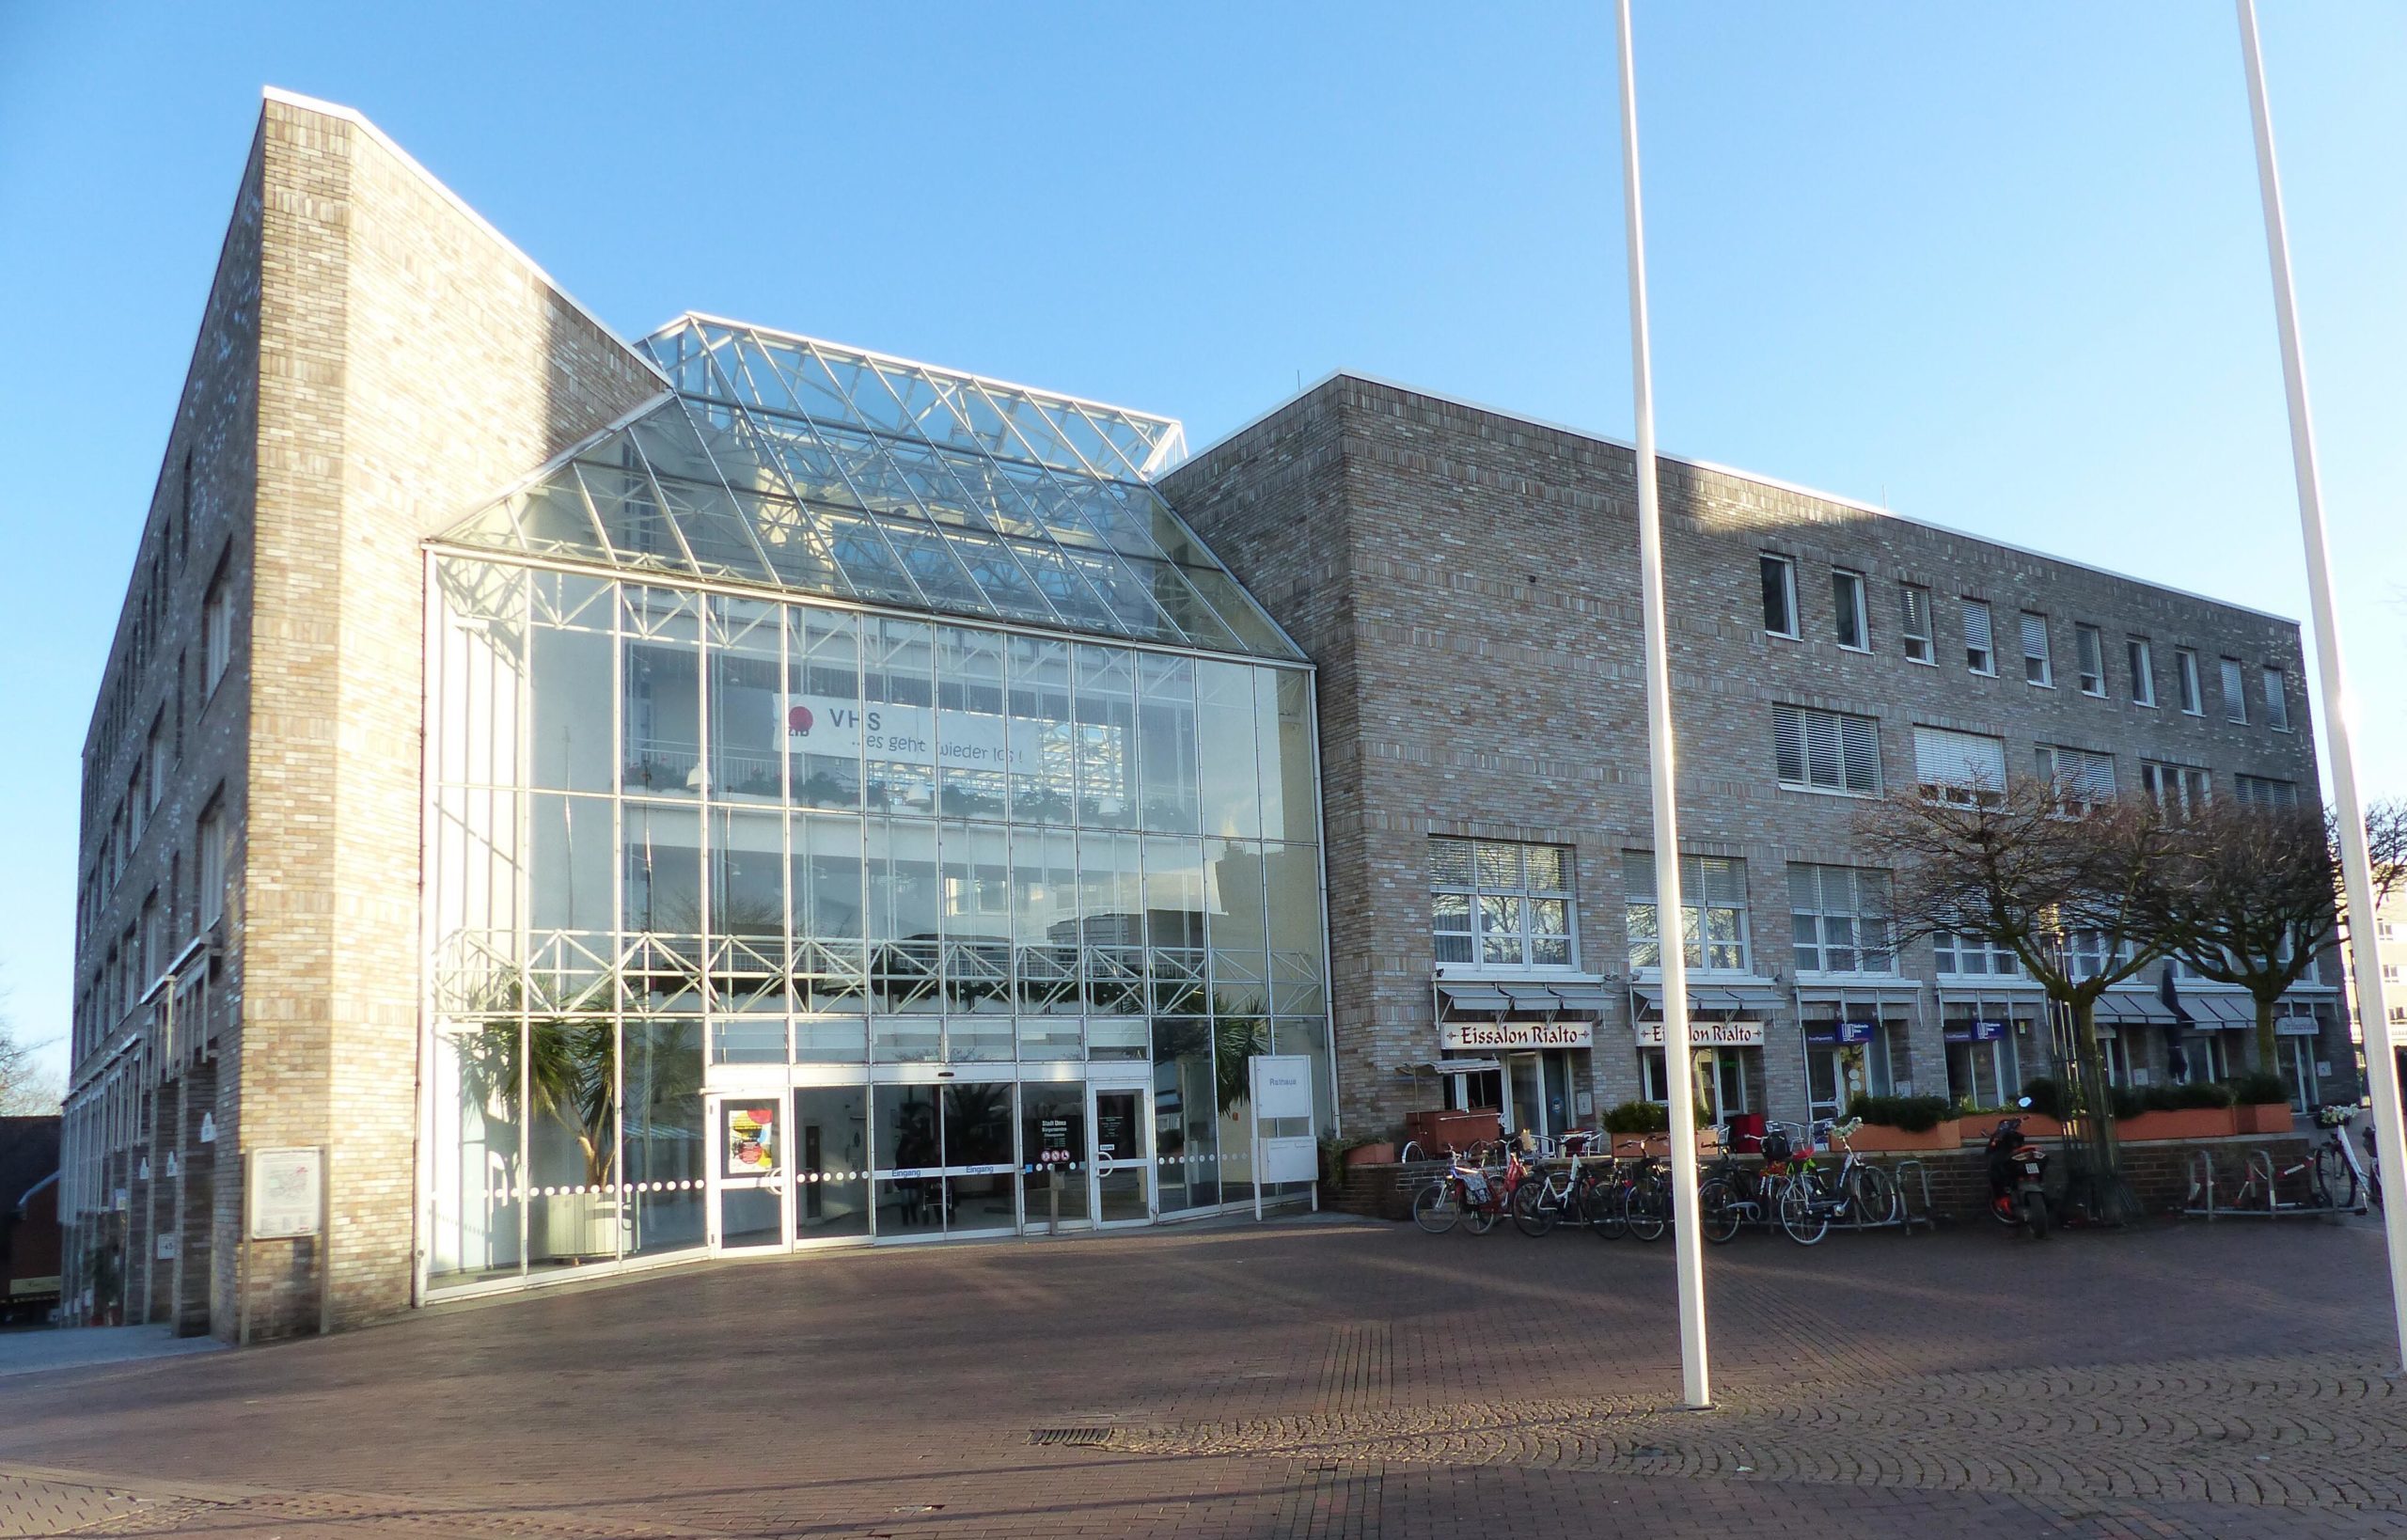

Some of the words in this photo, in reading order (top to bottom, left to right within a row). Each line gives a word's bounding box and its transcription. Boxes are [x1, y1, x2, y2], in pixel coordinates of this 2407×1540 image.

[829, 708, 881, 731] VHS
[888, 736, 926, 752] geht
[1461, 1026, 1529, 1045] Eissalon
[1532, 1025, 1578, 1044] Rialto
[1652, 1025, 1709, 1042] Eilon
[1712, 1025, 1752, 1042] Rialto
[891, 1169, 921, 1177] Eingang
[966, 1165, 995, 1174] Eingang
